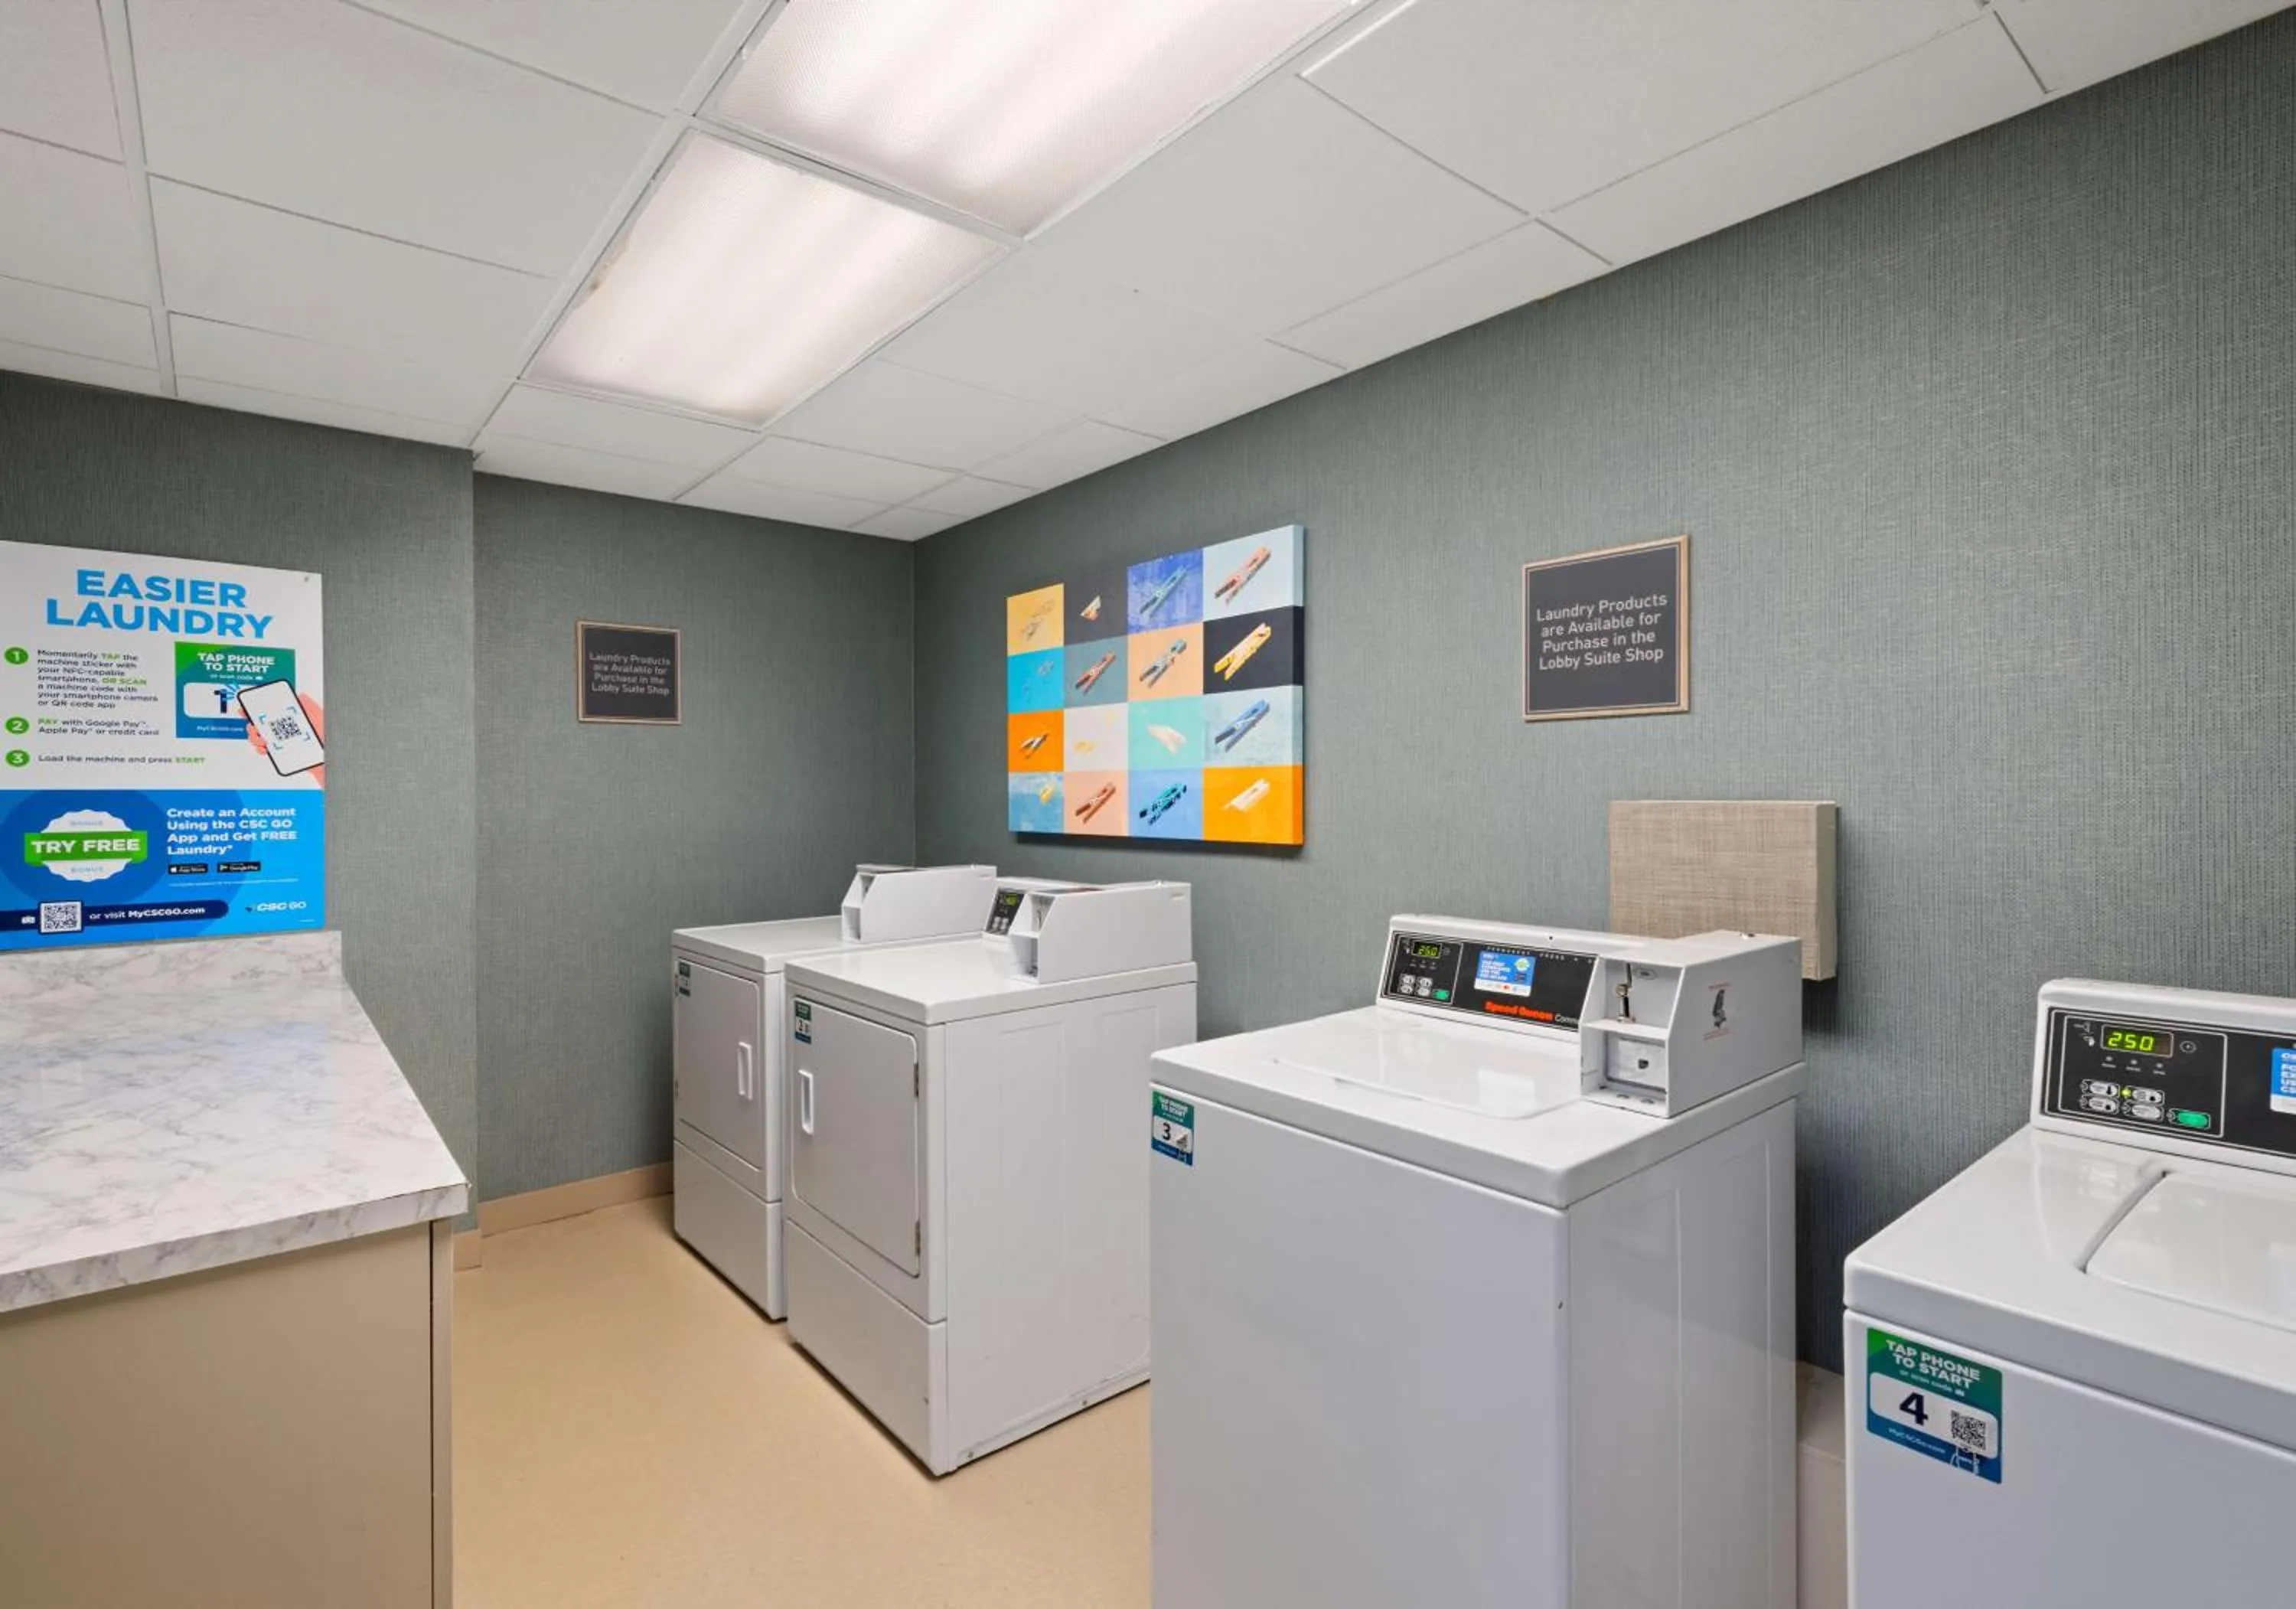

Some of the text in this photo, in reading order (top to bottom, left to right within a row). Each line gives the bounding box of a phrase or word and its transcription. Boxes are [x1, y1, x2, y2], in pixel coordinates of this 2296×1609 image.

[77, 570, 247, 609] EASIER
[1536, 594, 1668, 622] Laundry Products
[47, 599, 274, 638] LAUNDRY
[1541, 612, 1662, 638] are Available for
[1542, 630, 1656, 653] Purchase in the
[38, 650, 98, 660] Momentarily
[197, 652, 276, 665] TAP PHONE
[589, 652, 670, 665] Laundry Products
[1539, 648, 1664, 671] Lobby Suite Shop
[82, 659, 114, 667] sticker
[204, 662, 269, 674] TO START
[611, 664, 653, 674] Available
[38, 666, 60, 674] your
[594, 672, 665, 685] Purchase in the
[592, 682, 670, 697] Lobby Suite Shop
[63, 692, 121, 701] smartphone
[214, 689, 227, 713] 1
[38, 726, 68, 735] Apple
[38, 754, 64, 762] Load
[85, 755, 125, 763] machine
[167, 808, 215, 818] Create
[240, 808, 297, 817] Account
[167, 819, 292, 831] Using the CSC GO
[167, 831, 297, 844] App and Get FREE
[31, 838, 141, 853] TRY FREE
[257, 900, 307, 912] CSC GO
[128, 907, 206, 919] MyCSCGO.com
[1485, 1001, 1518, 1015] Speed
[1518, 1007, 1553, 1020] Queen
[2108, 1032, 2154, 1052] 250
[1162, 1122, 1170, 1141] 3
[1886, 1340, 1981, 1381] TAP PHONE
[1893, 1353, 1975, 1389] TO START
[1899, 1392, 1929, 1426] 4
